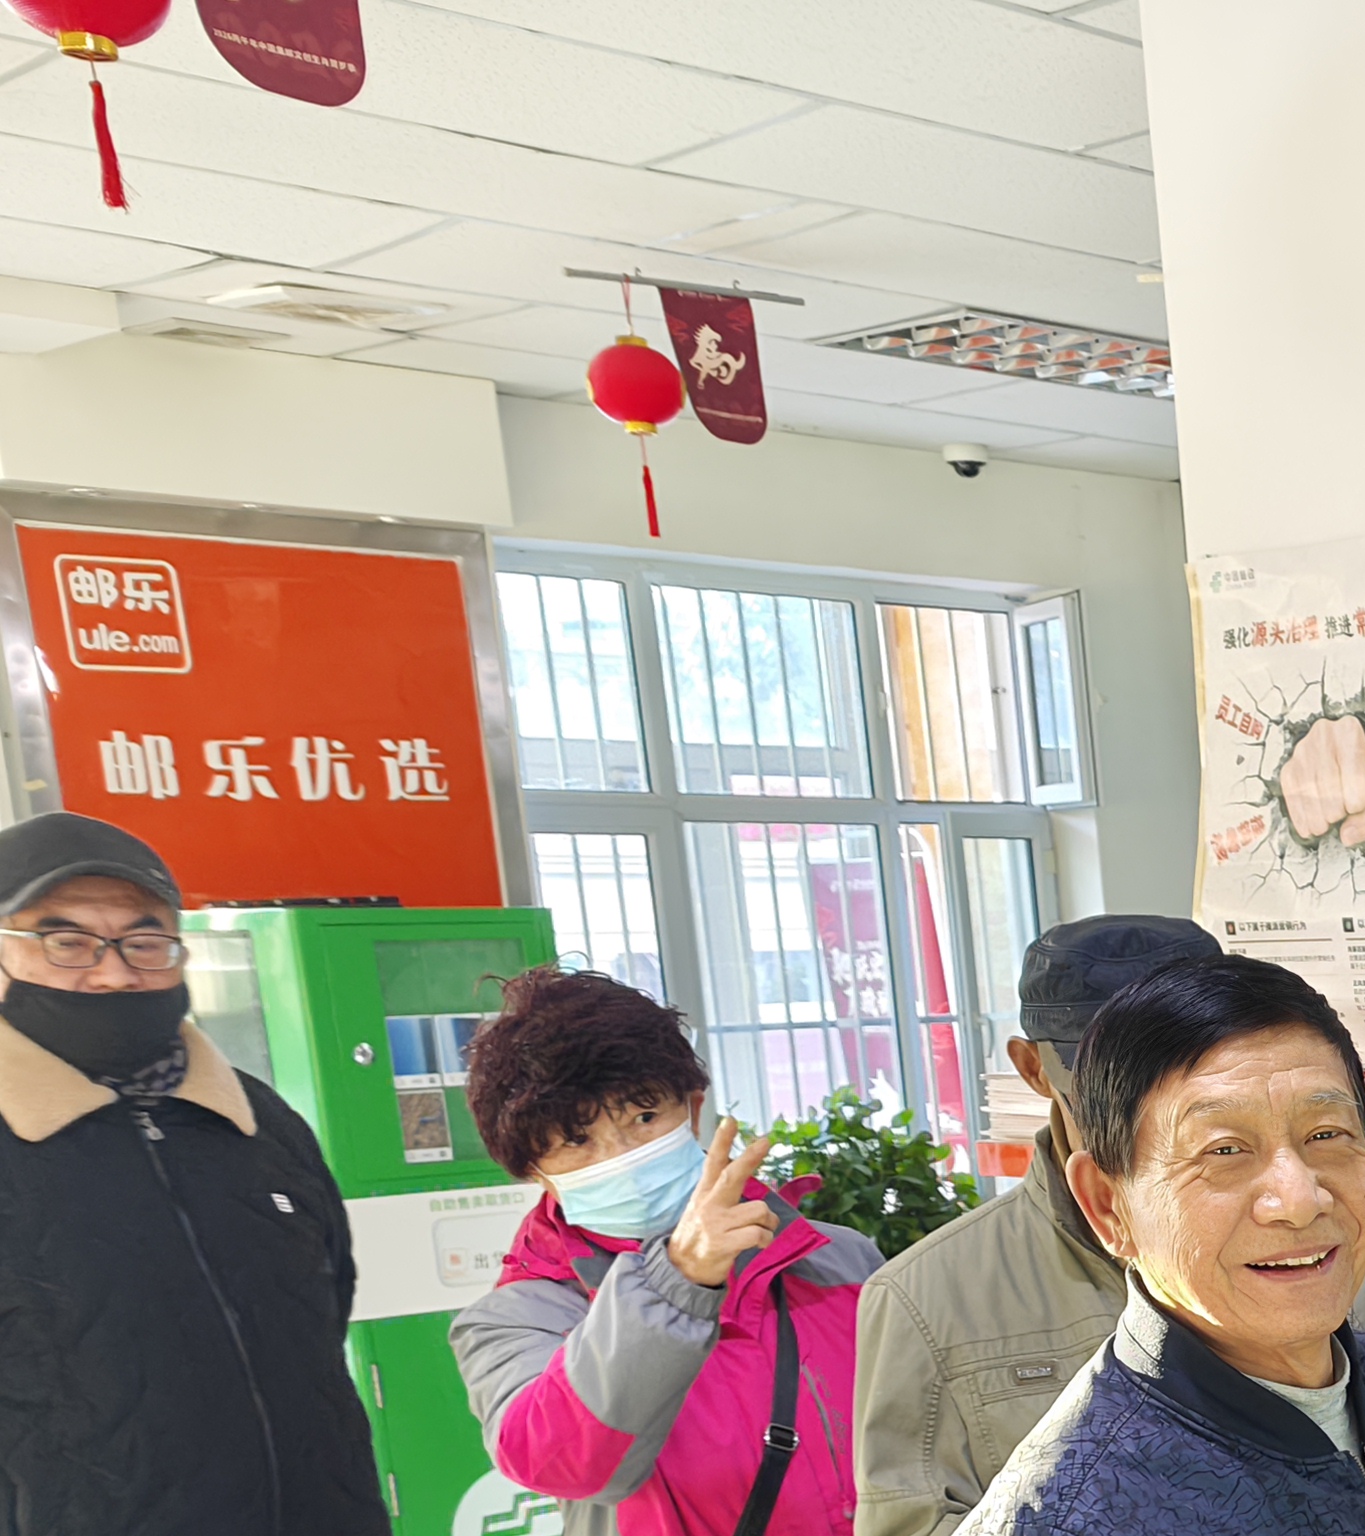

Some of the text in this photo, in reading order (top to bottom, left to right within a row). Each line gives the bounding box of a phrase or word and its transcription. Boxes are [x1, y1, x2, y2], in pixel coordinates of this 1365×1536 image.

[67, 565, 170, 616] 邮乐
[78, 622, 180, 655] ule.com
[98, 730, 450, 803] 邮乐优选
